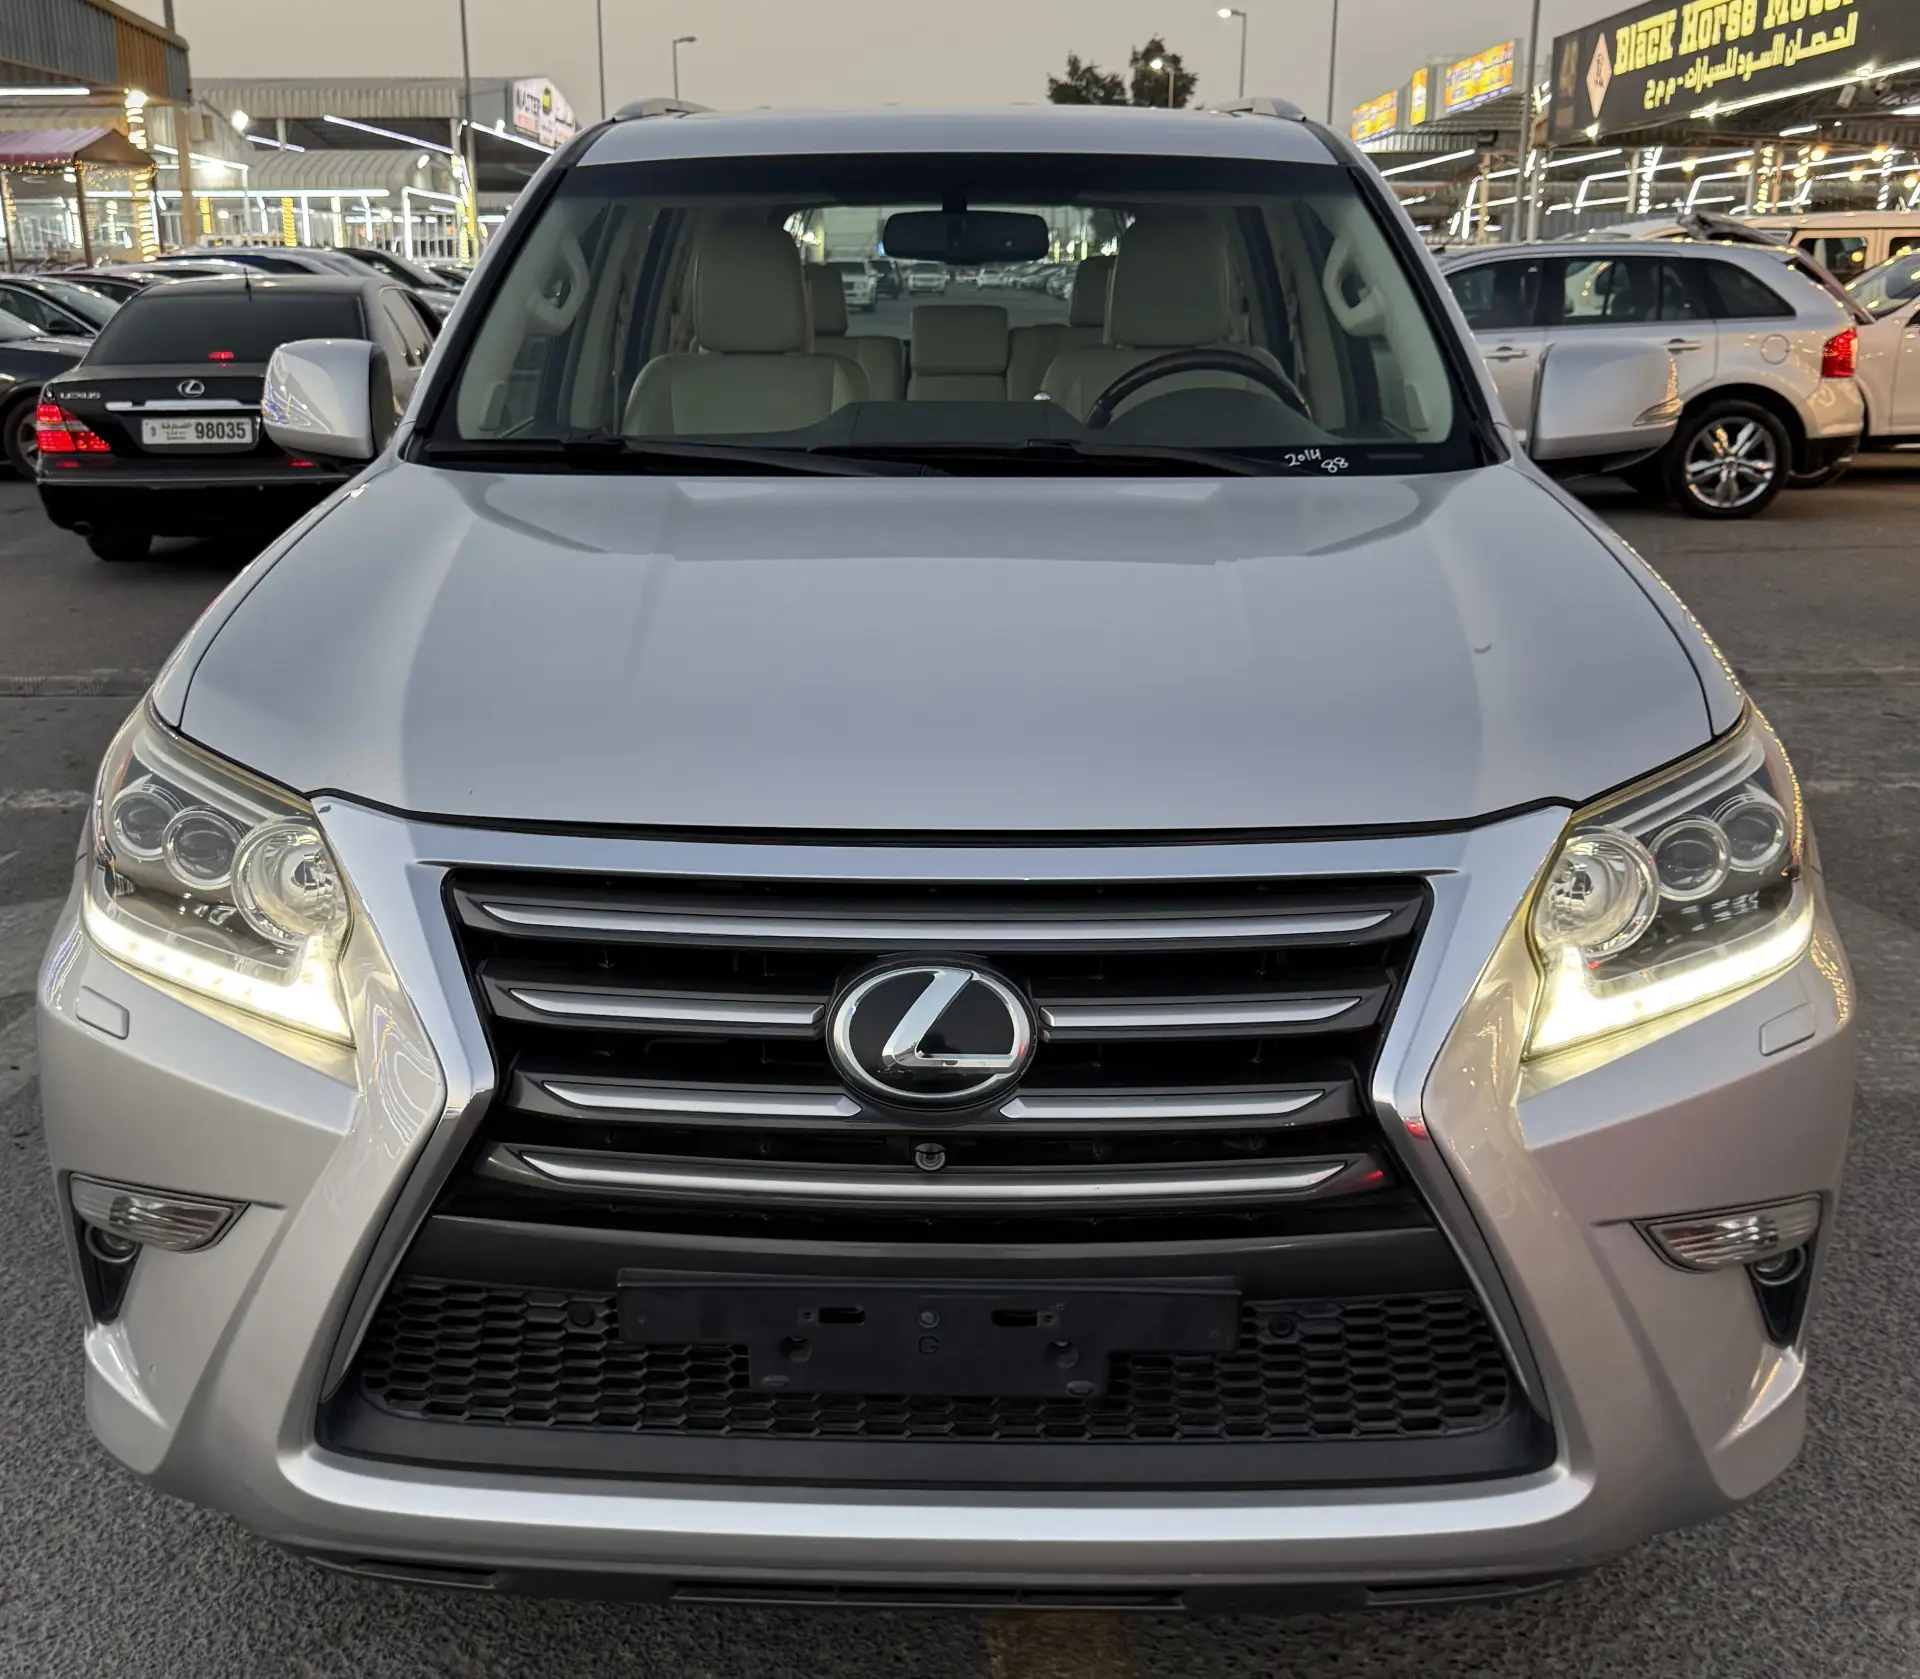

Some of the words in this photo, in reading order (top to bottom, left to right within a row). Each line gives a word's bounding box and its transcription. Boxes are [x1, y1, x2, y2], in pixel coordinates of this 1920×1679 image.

[1613, 8, 1677, 76] Black
[1678, 0, 1758, 55] Horse
[1784, 11, 1858, 67] الحصان
[195, 422, 246, 439] 98035
[1284, 448, 1322, 467] 2014
[1320, 457, 1349, 473] 88
